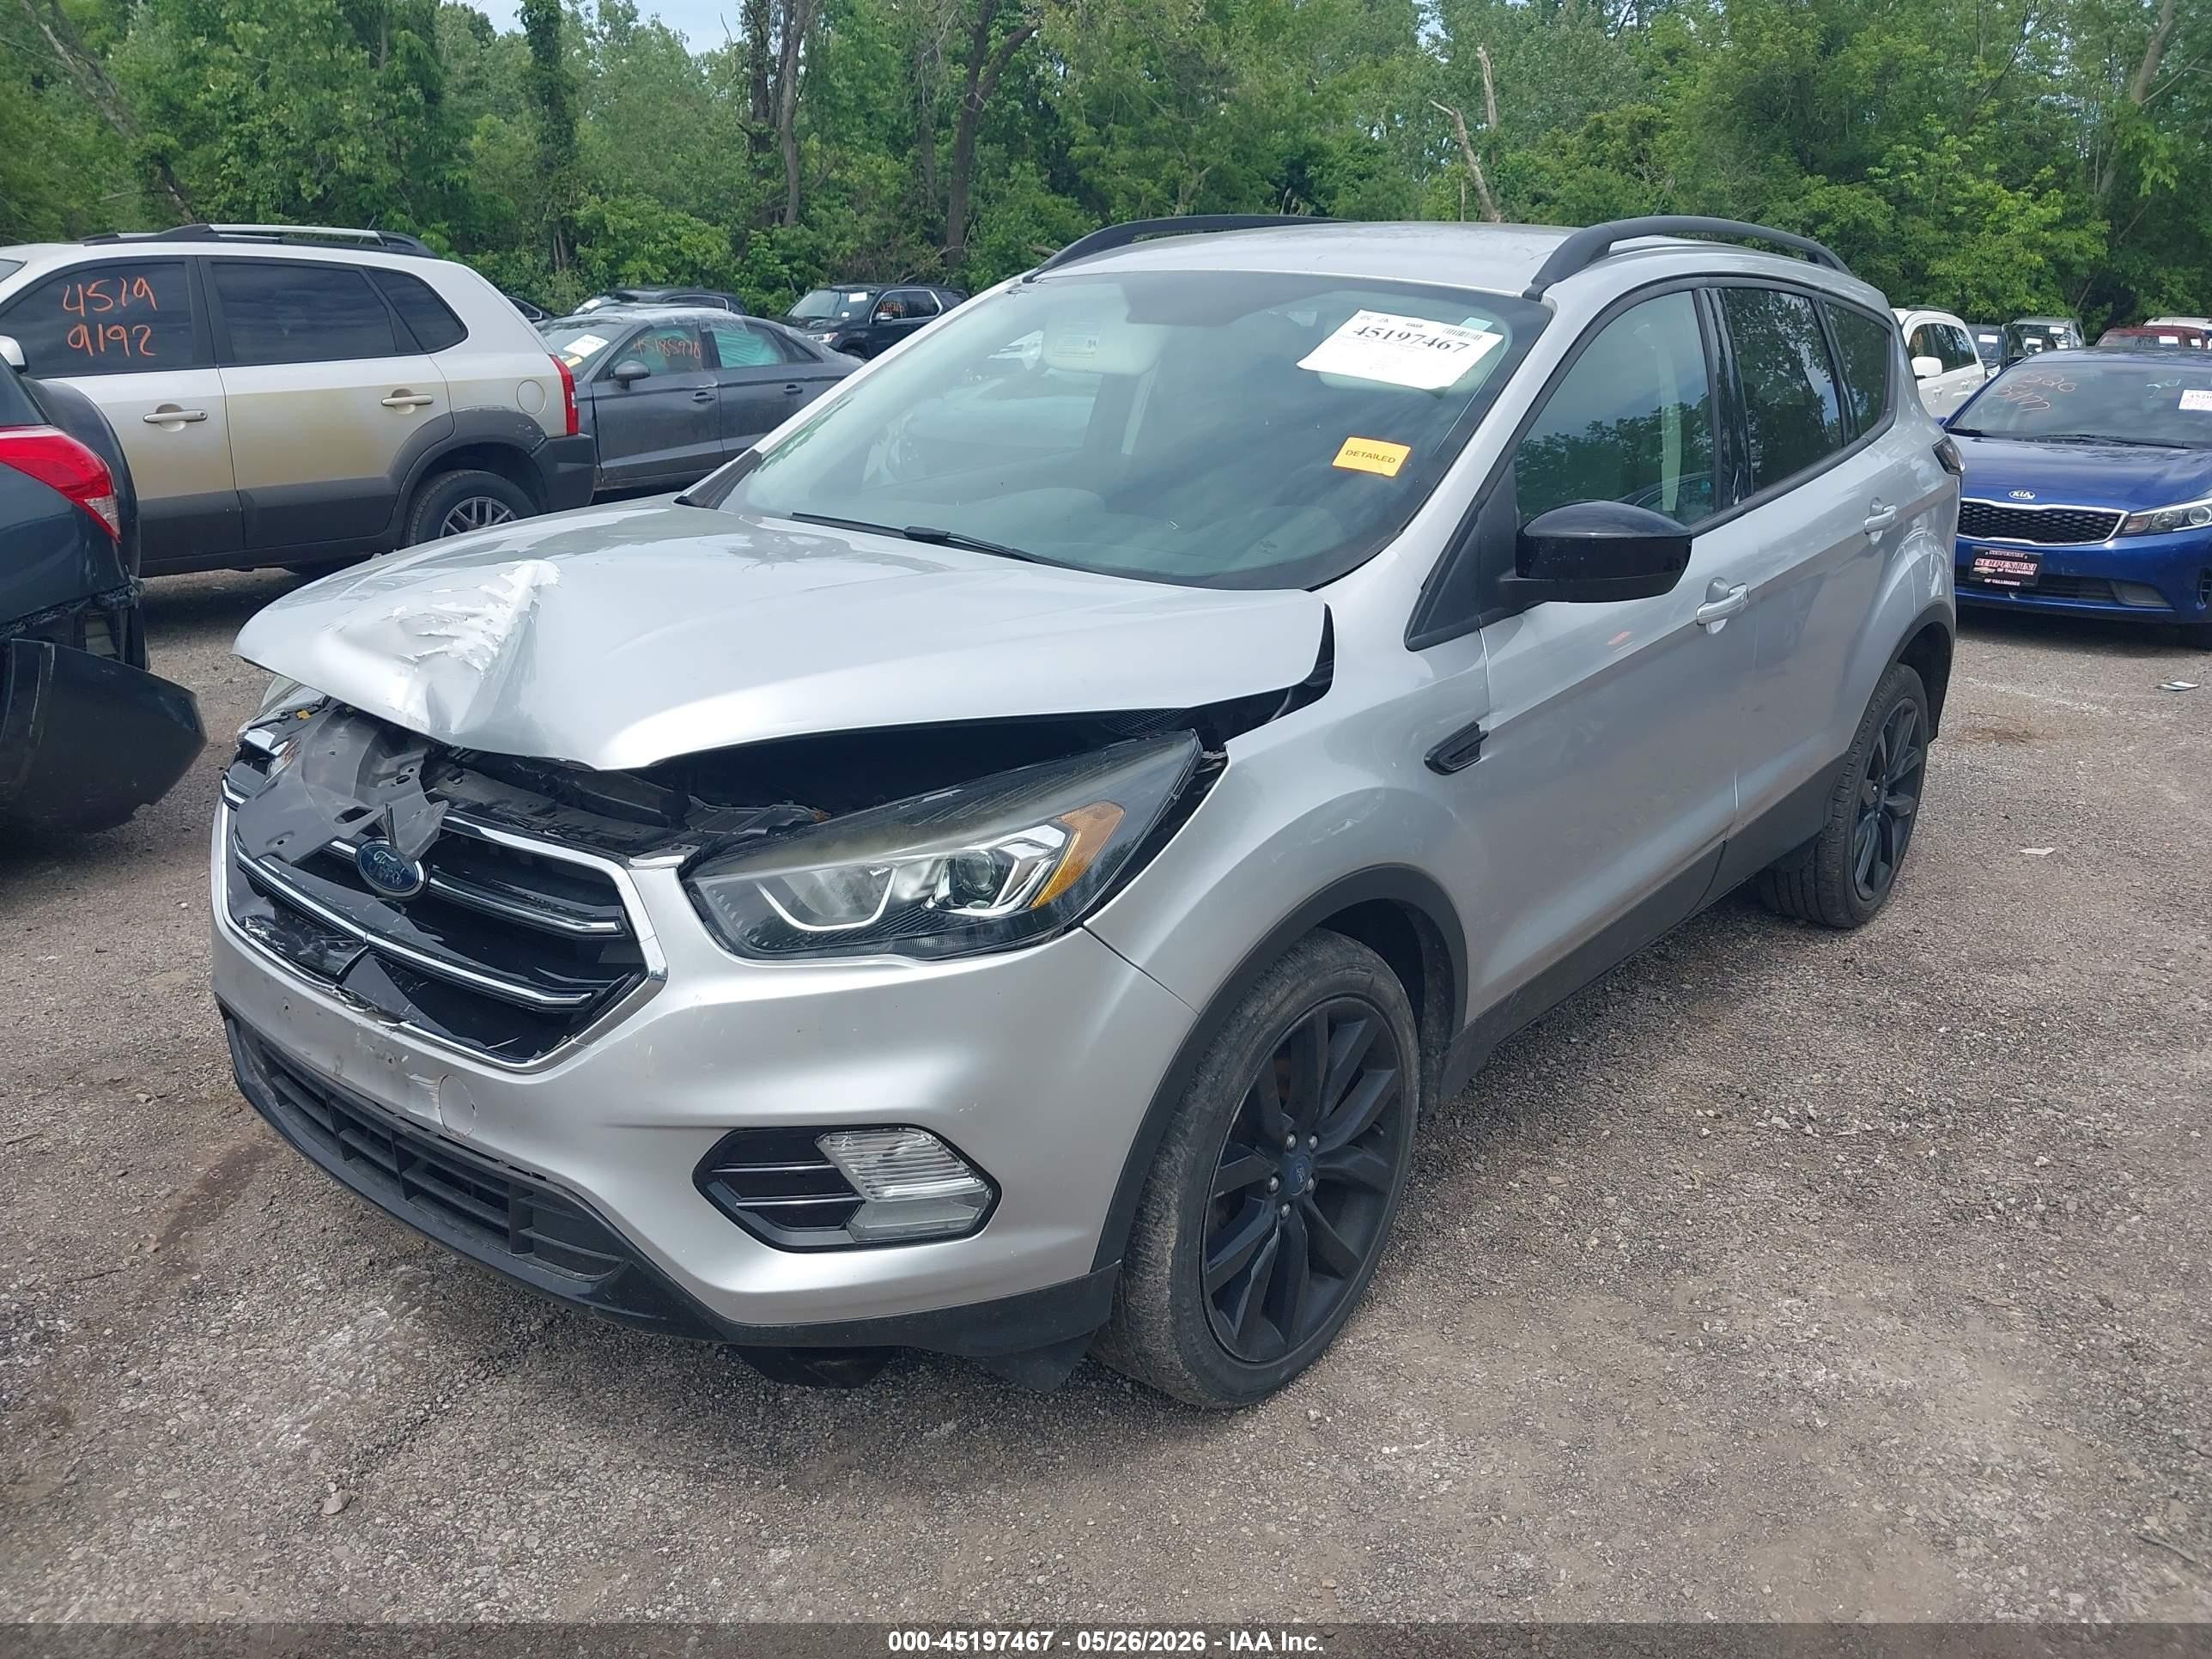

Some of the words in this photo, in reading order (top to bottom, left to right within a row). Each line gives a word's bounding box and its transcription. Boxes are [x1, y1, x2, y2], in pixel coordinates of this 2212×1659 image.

[63, 276, 158, 317] 4519
[67, 323, 157, 357] 9192
[1352, 325, 1471, 354] 45197467
[1345, 449, 1396, 464] DETAILED
[1975, 558, 2038, 571] SERPENTINI
